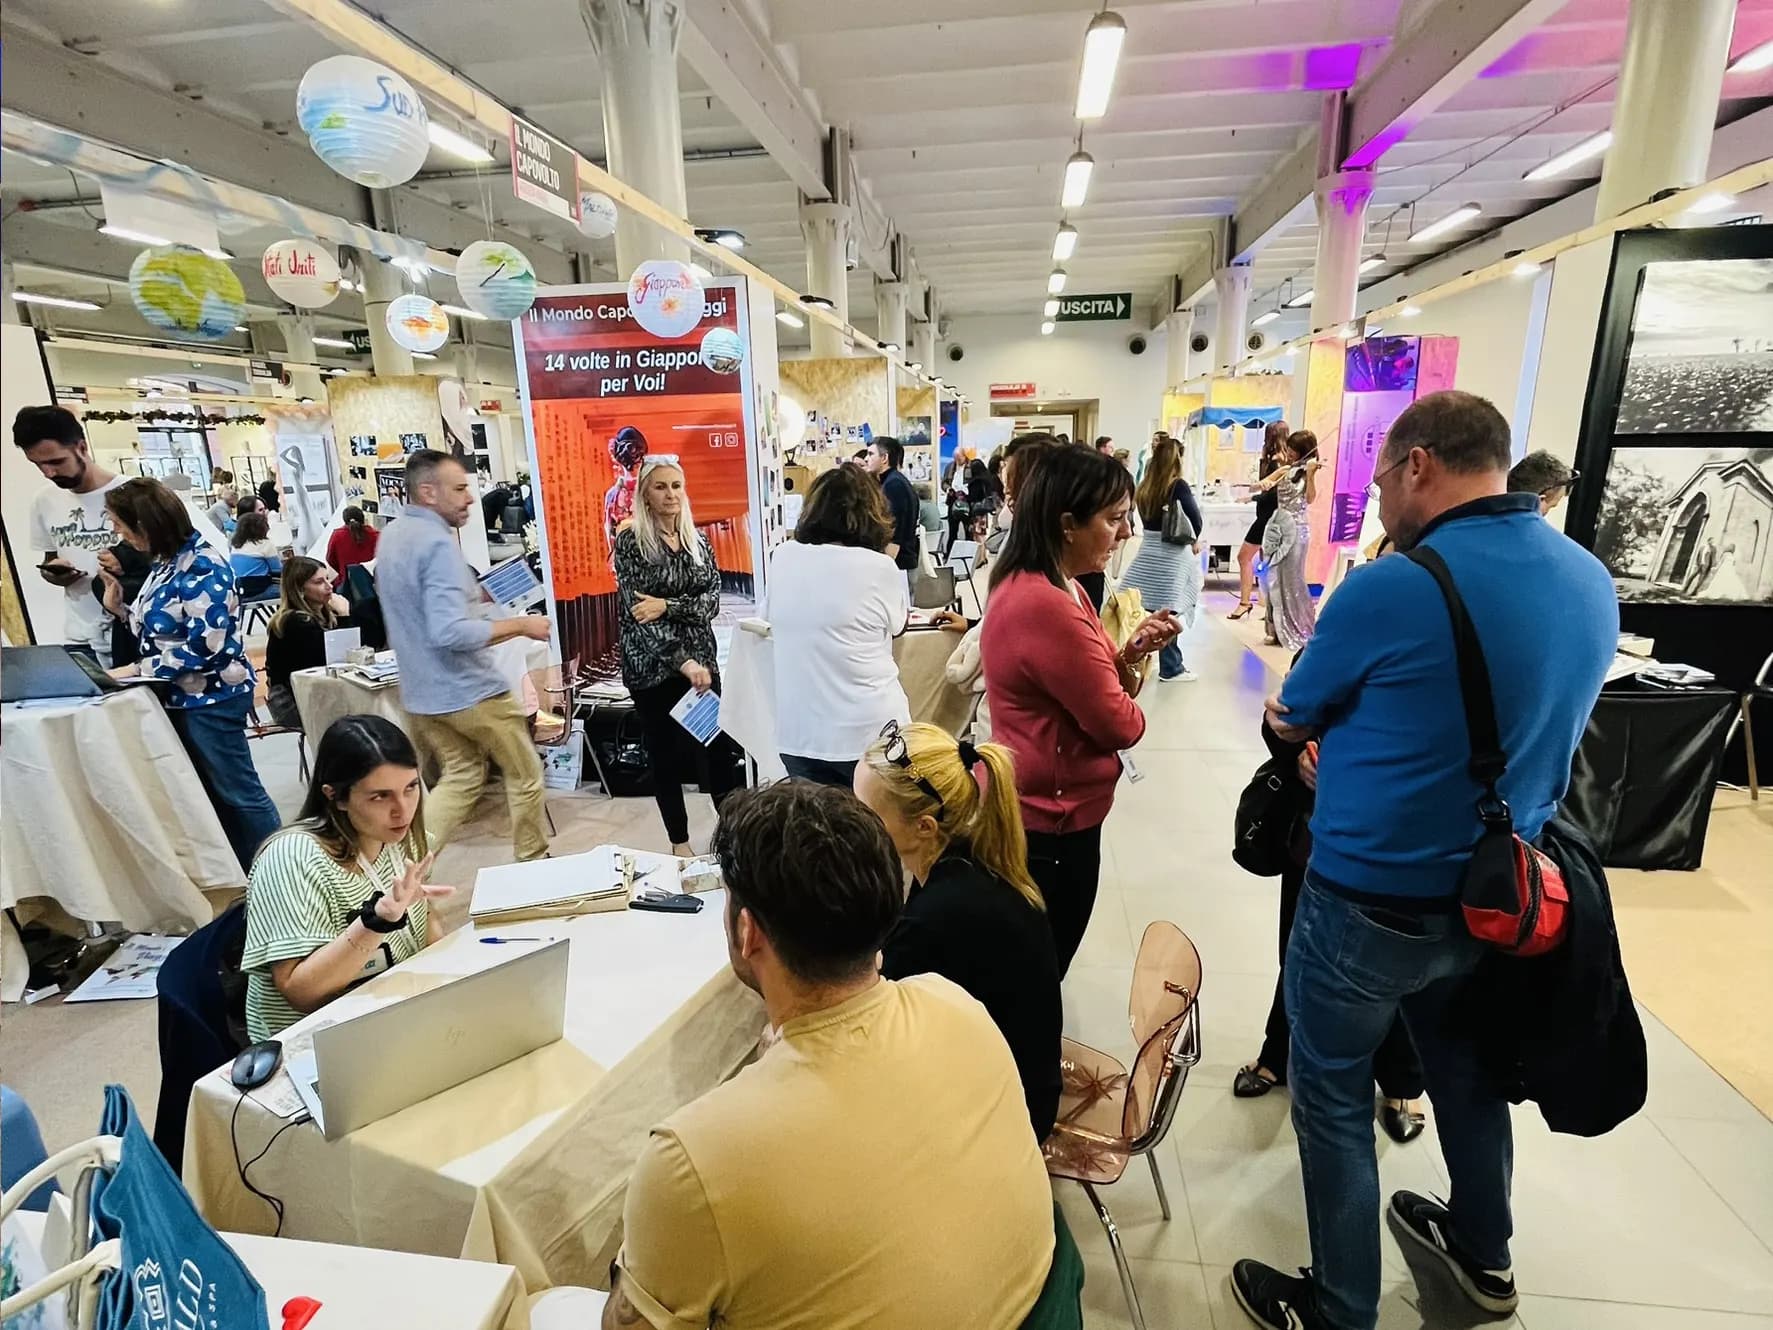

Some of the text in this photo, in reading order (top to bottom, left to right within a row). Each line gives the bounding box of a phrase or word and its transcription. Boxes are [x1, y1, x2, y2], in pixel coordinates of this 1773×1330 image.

[513, 123, 551, 163] IL MONDO
[516, 150, 560, 191] CAPOVOLTO
[288, 249, 316, 276] Uniti
[529, 307, 538, 322] Il
[541, 305, 593, 321] Mondo
[1060, 299, 1115, 315] USCITA
[544, 353, 565, 372] 14
[569, 351, 610, 370] volte
[615, 350, 631, 369] in
[600, 373, 665, 397] per Voi!
[208, 1283, 217, 1313] SPA
